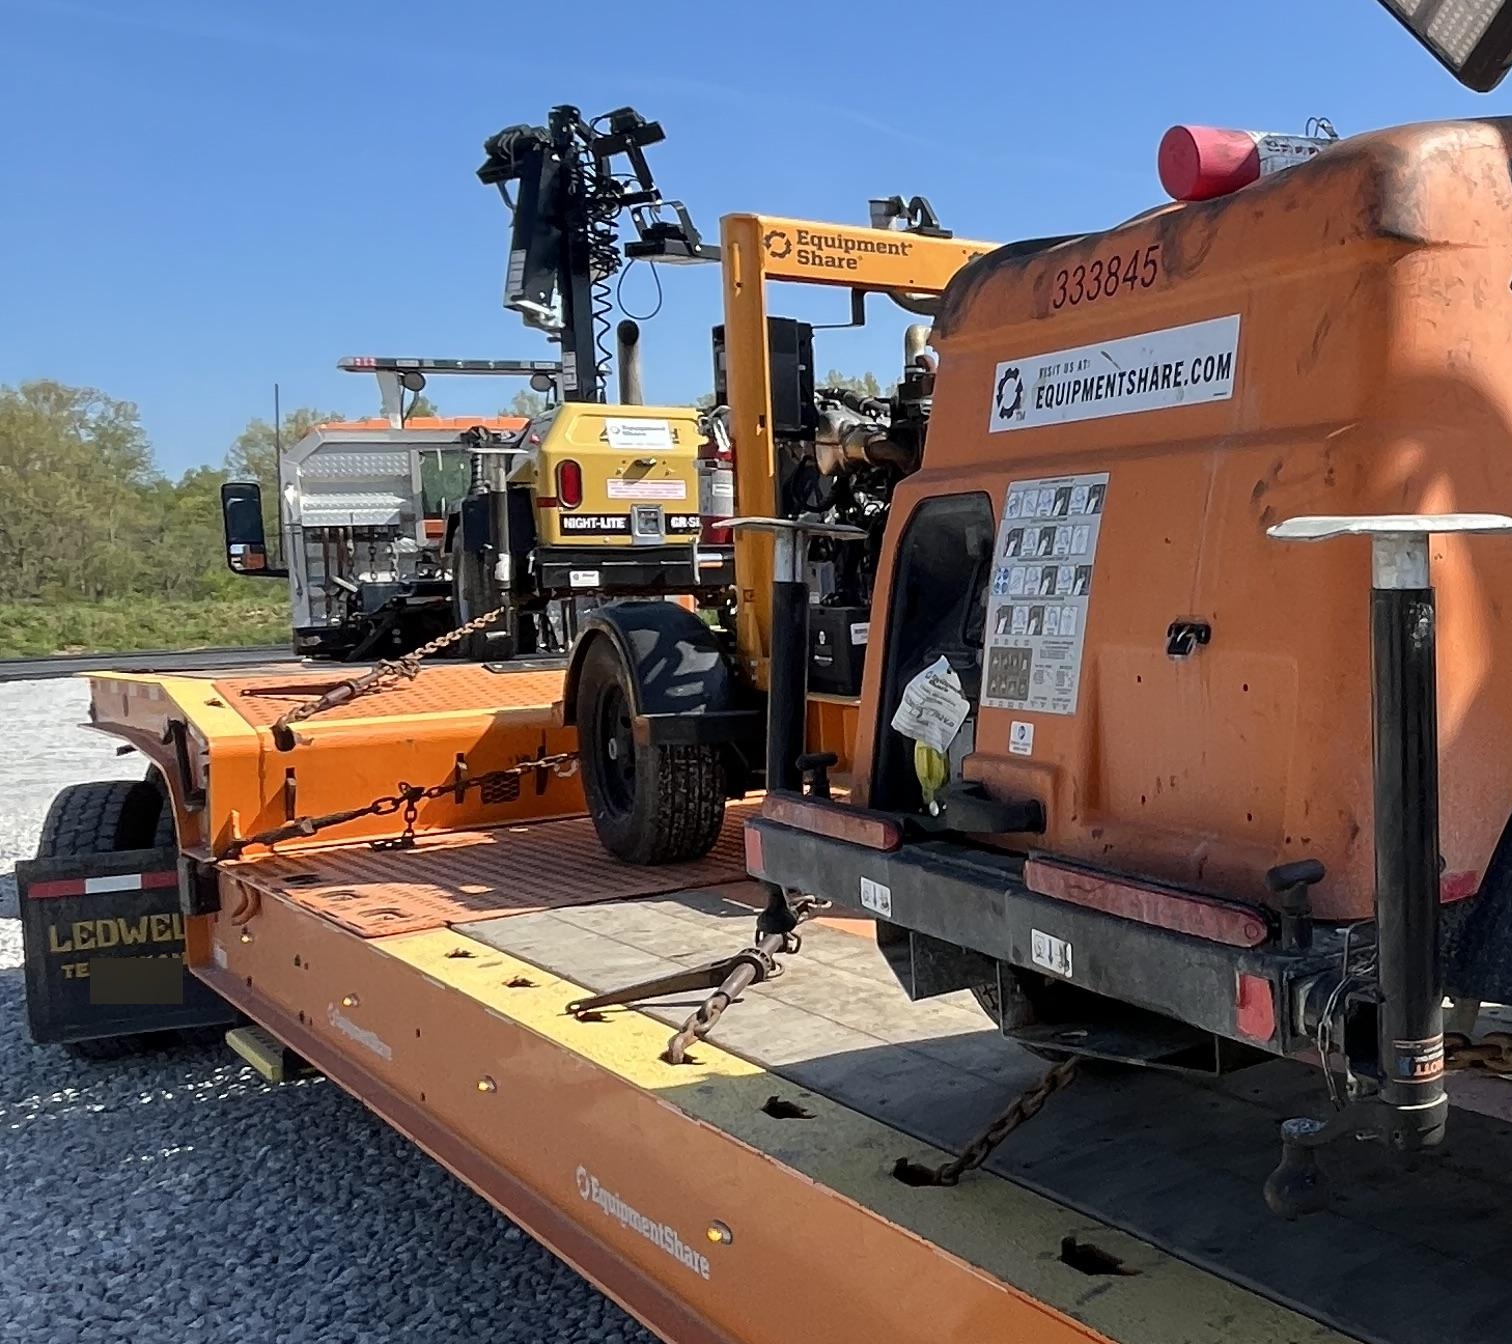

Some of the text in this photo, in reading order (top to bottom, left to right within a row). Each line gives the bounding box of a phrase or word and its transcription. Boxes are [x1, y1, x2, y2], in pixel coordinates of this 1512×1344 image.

[796, 229, 909, 256] Equipment
[796, 249, 858, 270] Share
[1052, 243, 1160, 309] 333845
[1035, 352, 1232, 411] EQUIPMENTSHARE.COM
[1039, 364, 1061, 378] VISIT
[1063, 361, 1074, 374] US
[563, 516, 626, 530] NIGHT-LITE
[49, 912, 185, 953] LEDWEL
[590, 1174, 711, 1281] EquipmentShare
